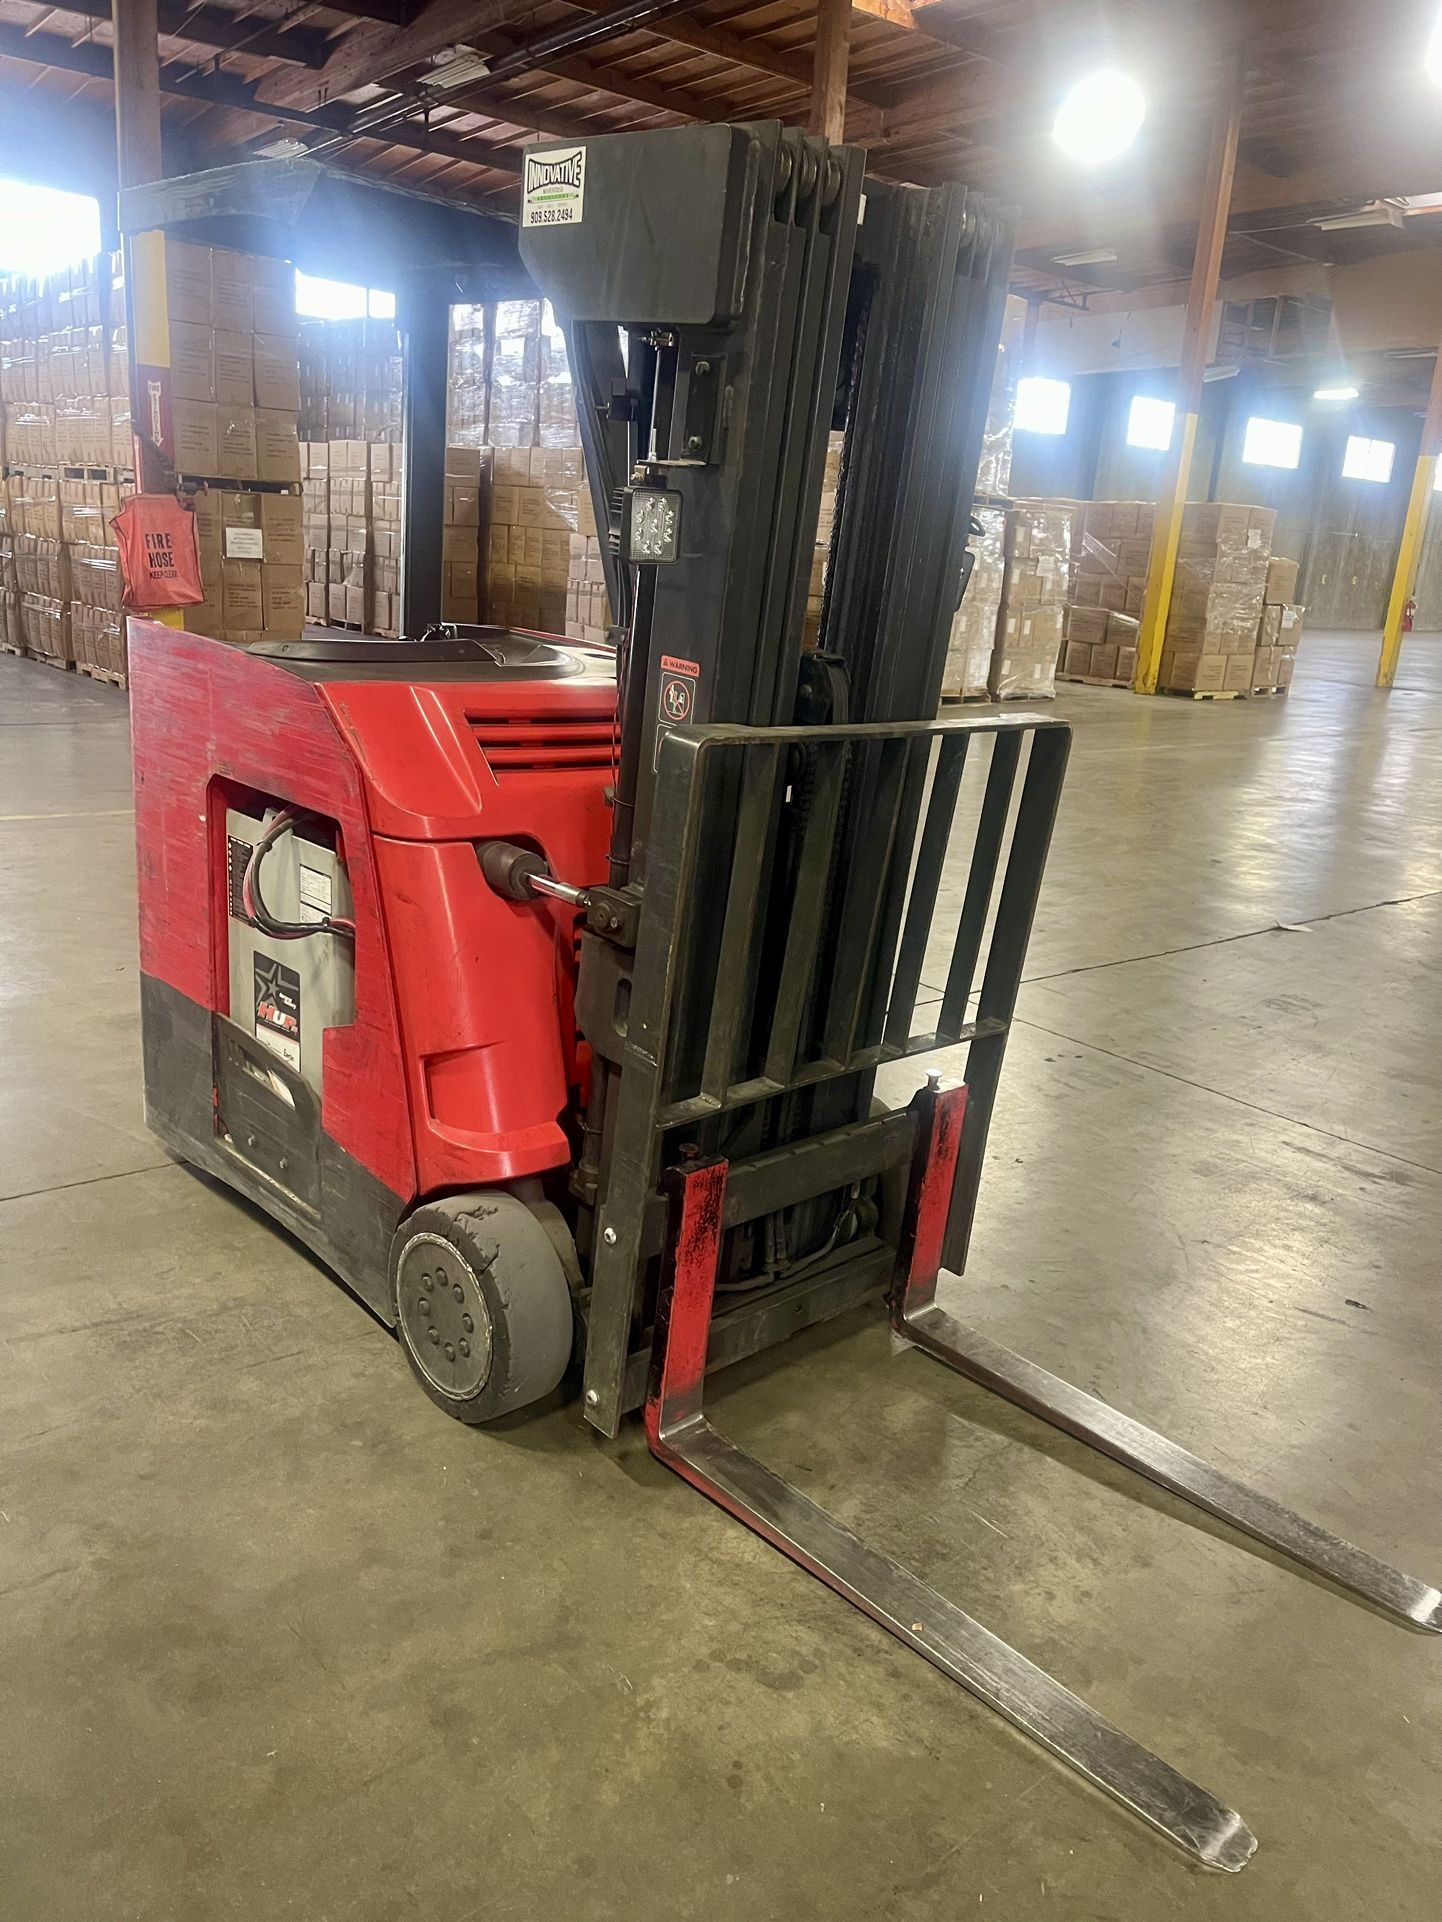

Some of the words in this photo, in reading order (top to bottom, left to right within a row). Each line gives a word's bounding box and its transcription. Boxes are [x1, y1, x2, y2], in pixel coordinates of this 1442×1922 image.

[527, 151, 582, 194] INNOVATIVE
[530, 208, 573, 224] 909.528.2494
[144, 533, 172, 549] FIRE
[148, 551, 175, 568] HOSE
[150, 570, 163, 580] KEEP
[669, 660, 698, 674] WARNING
